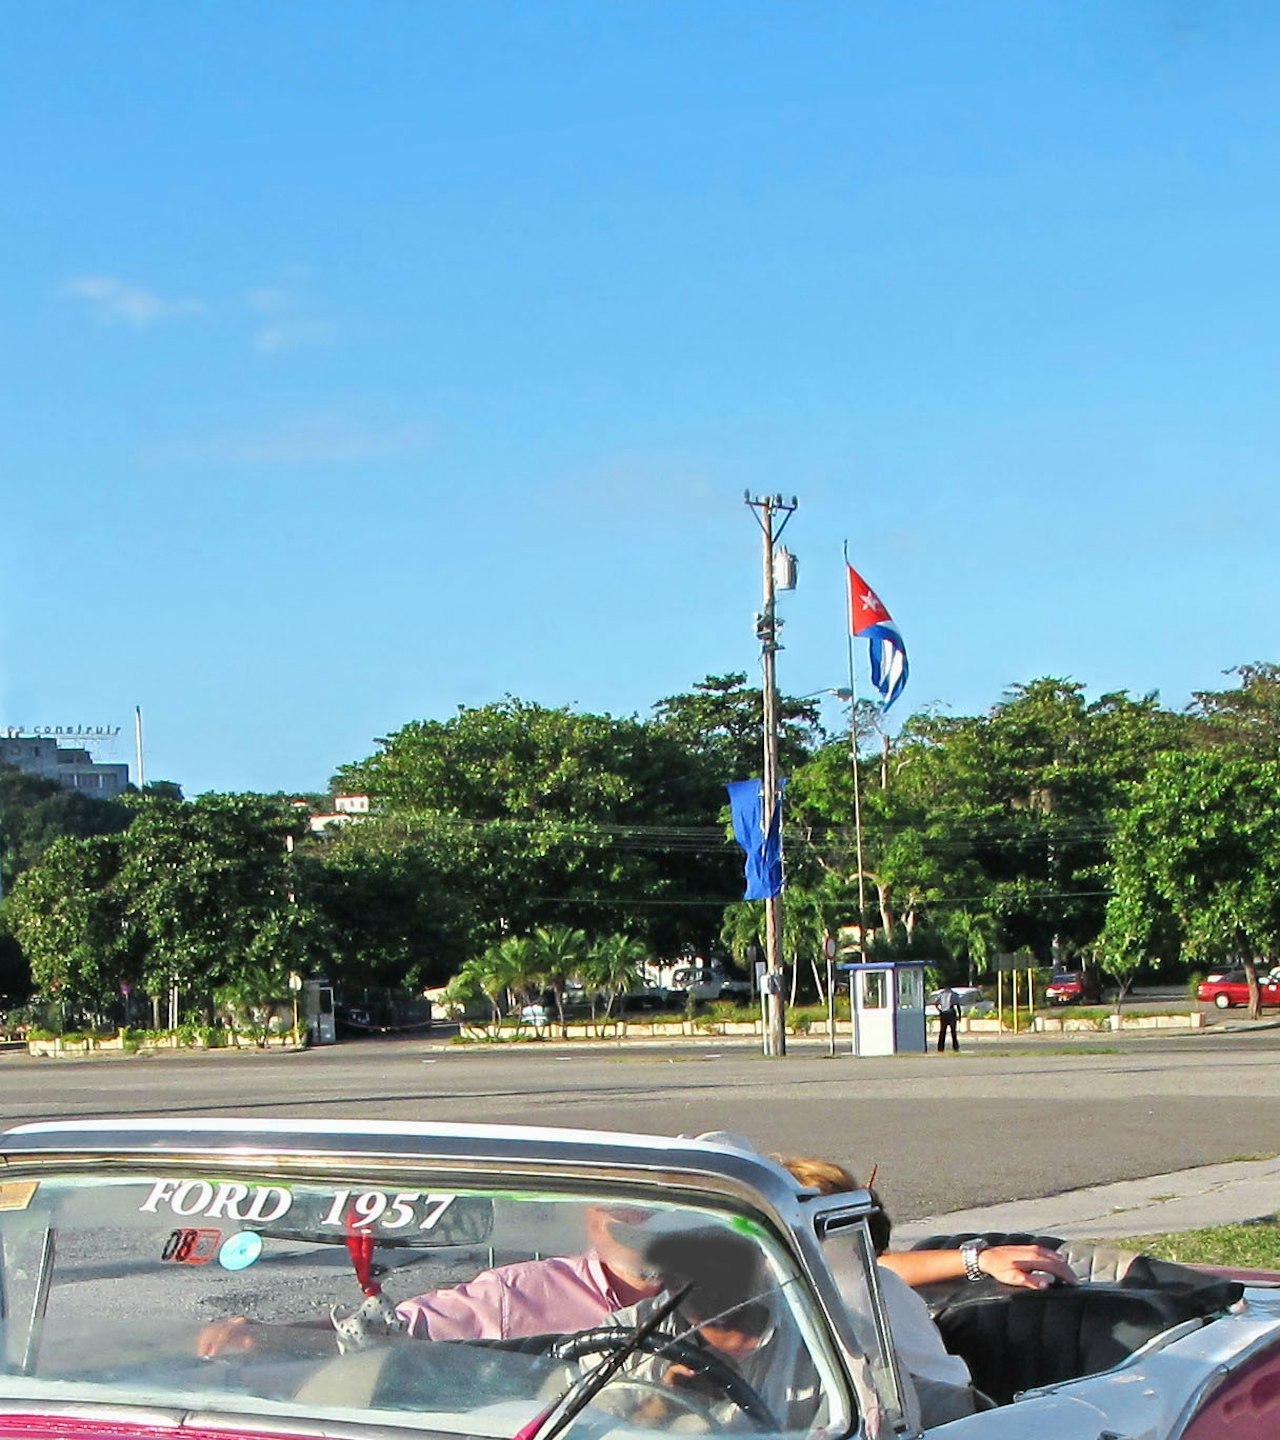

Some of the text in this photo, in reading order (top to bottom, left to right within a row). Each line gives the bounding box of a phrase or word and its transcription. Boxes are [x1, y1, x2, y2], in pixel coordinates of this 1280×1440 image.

[33, 724, 121, 735] construir
[139, 1177, 458, 1229] FORD 1957
[161, 1228, 198, 1262] 08
